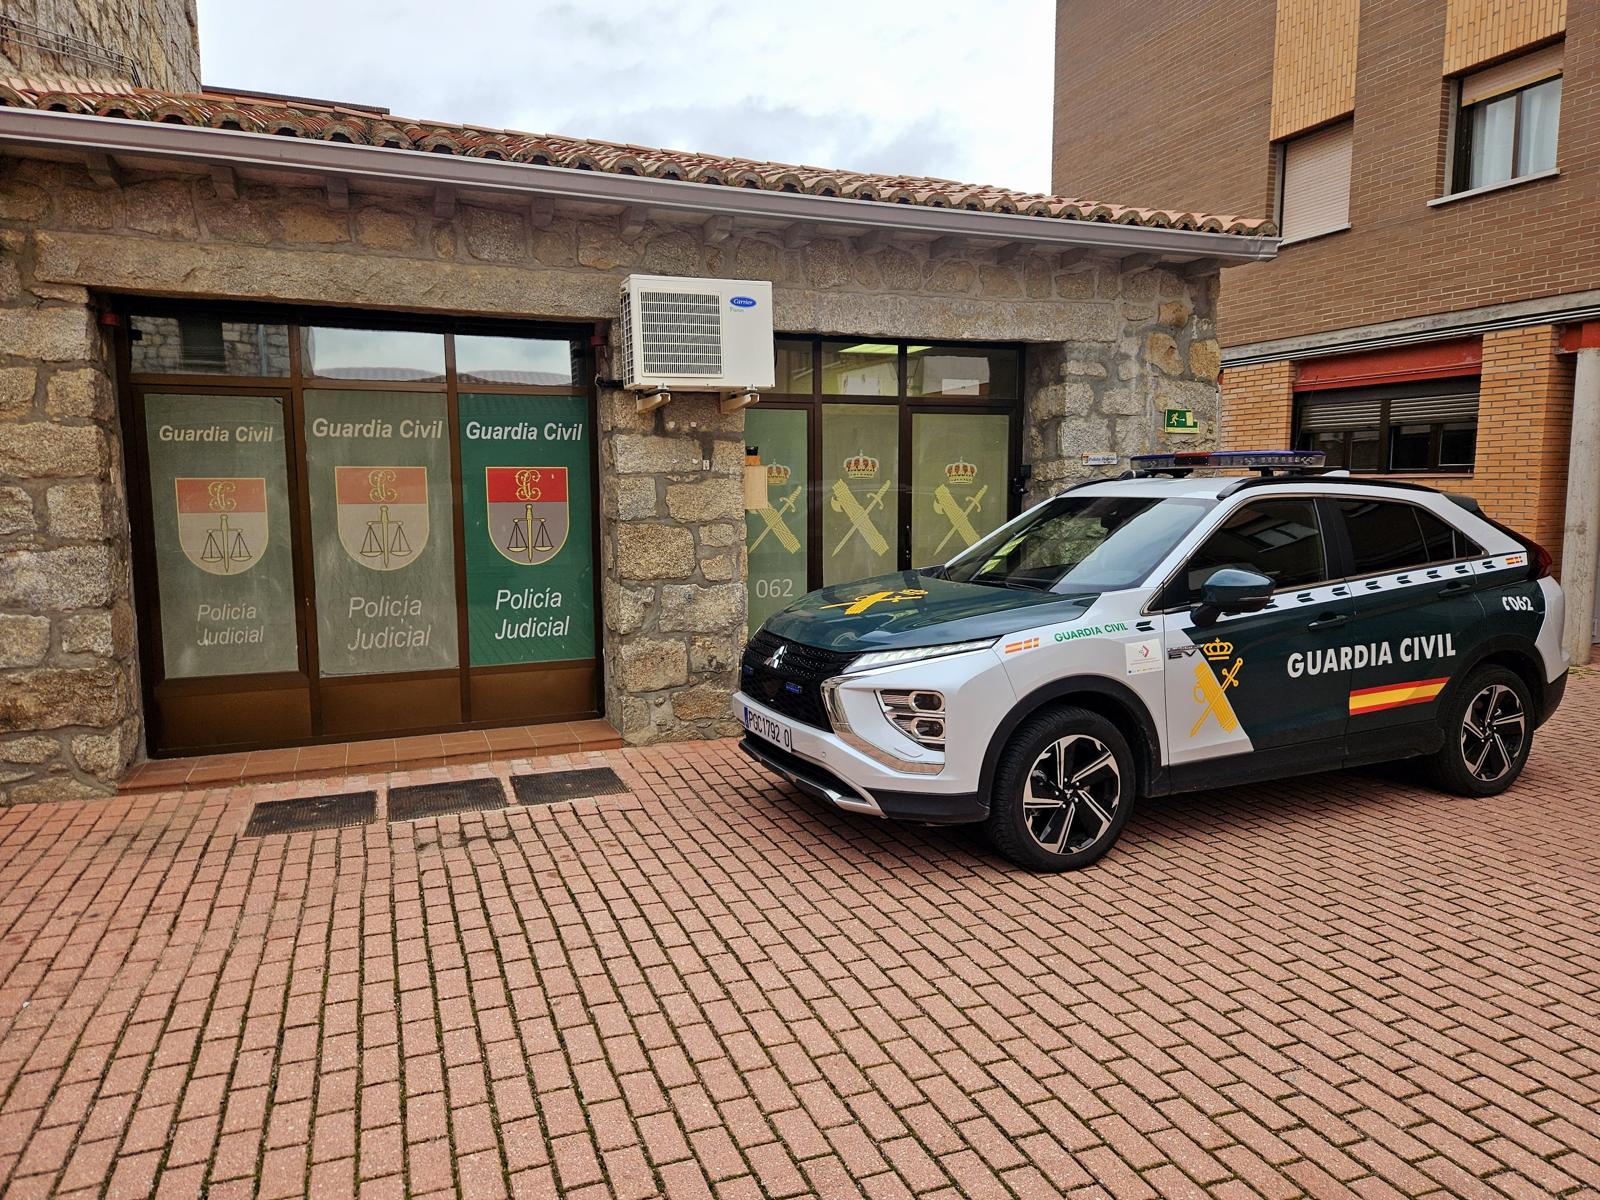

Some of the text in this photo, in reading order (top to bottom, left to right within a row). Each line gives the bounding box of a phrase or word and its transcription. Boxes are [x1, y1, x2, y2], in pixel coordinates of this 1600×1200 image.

[159, 425, 274, 442] Guardia Civil
[312, 418, 443, 439] Guardia Civil
[466, 421, 583, 441] Guardia Civil
[756, 578, 794, 598] 062
[348, 595, 423, 619] Policía
[495, 587, 563, 611] Policía
[196, 602, 257, 622] Policía
[197, 625, 265, 647] Judicial
[347, 624, 432, 651] Judicial
[494, 615, 570, 640] Judicial
[1054, 622, 1129, 642] GUARDIA CIVIL
[1287, 633, 1456, 678] GUARDIA CIVIL
